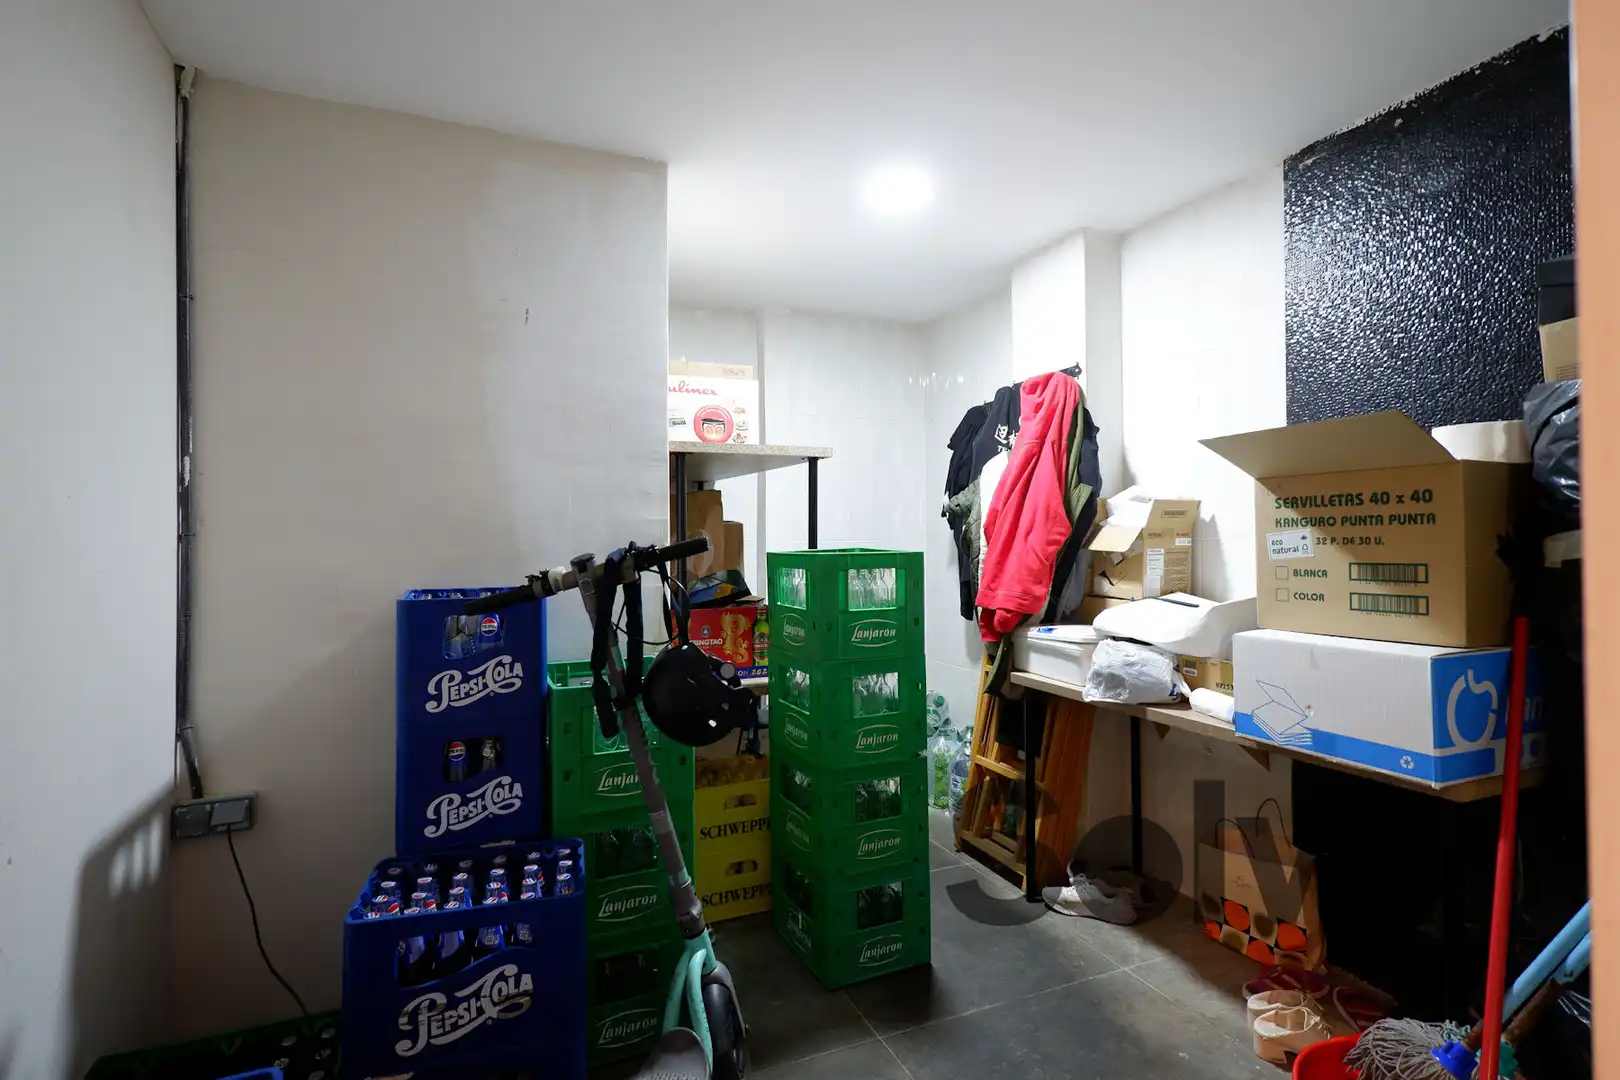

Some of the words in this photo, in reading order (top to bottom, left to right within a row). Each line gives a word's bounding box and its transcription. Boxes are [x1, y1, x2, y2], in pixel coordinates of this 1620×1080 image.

[1274, 492, 1364, 510] SERVILLETAS
[1369, 491, 1390, 505] 40
[1396, 494, 1405, 504] x
[1410, 489, 1433, 503] 40
[1275, 515, 1336, 529] KANGURO
[1341, 514, 1384, 527] PUNTA
[1389, 512, 1436, 526] PUNTA
[1315, 536, 1328, 546] 32
[1330, 536, 1340, 546] P.
[1342, 536, 1356, 545] DE
[1359, 536, 1371, 545] 30
[1375, 536, 1385, 545] U.
[1272, 545, 1300, 555] natural
[1293, 568, 1328, 579] BLANCA
[1293, 592, 1325, 602] COLOR
